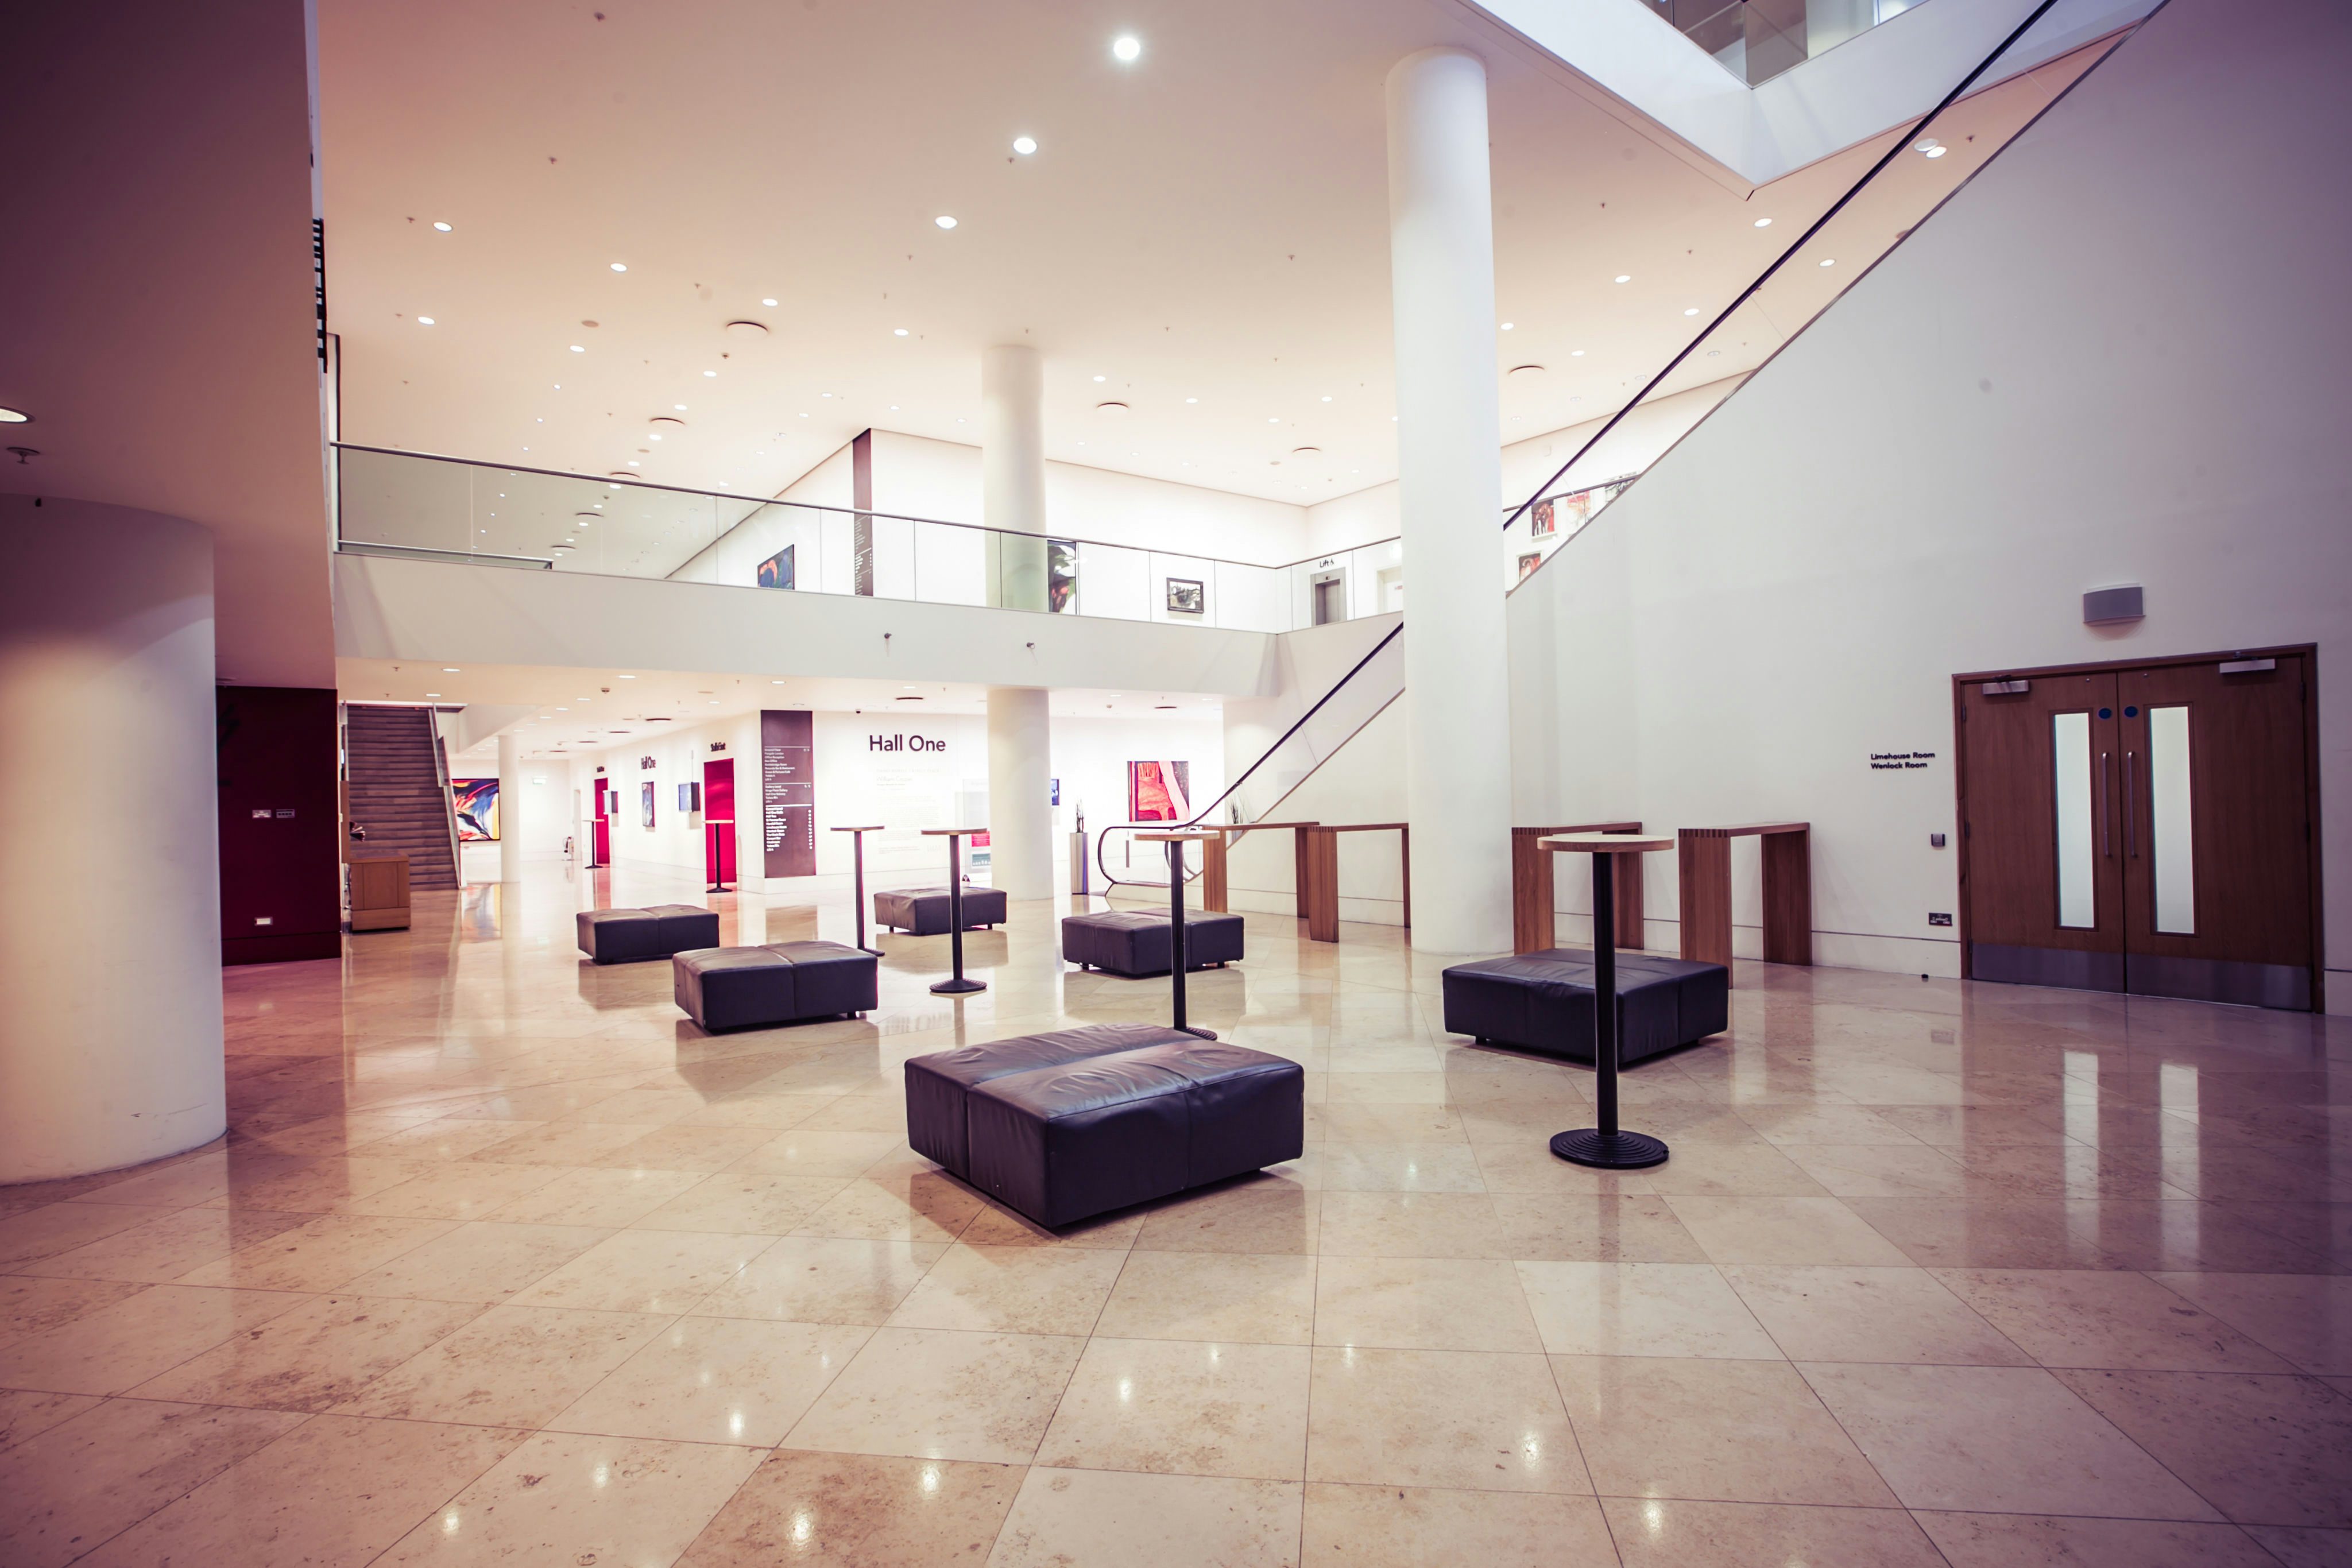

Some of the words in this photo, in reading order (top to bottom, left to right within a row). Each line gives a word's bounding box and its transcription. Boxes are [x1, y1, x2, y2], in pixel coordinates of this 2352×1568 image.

[1320, 559, 1329, 568] Lift
[869, 734, 903, 752] Hall
[909, 735, 946, 752] One
[1871, 752, 1910, 760] Limehouse
[648, 756, 656, 769] One
